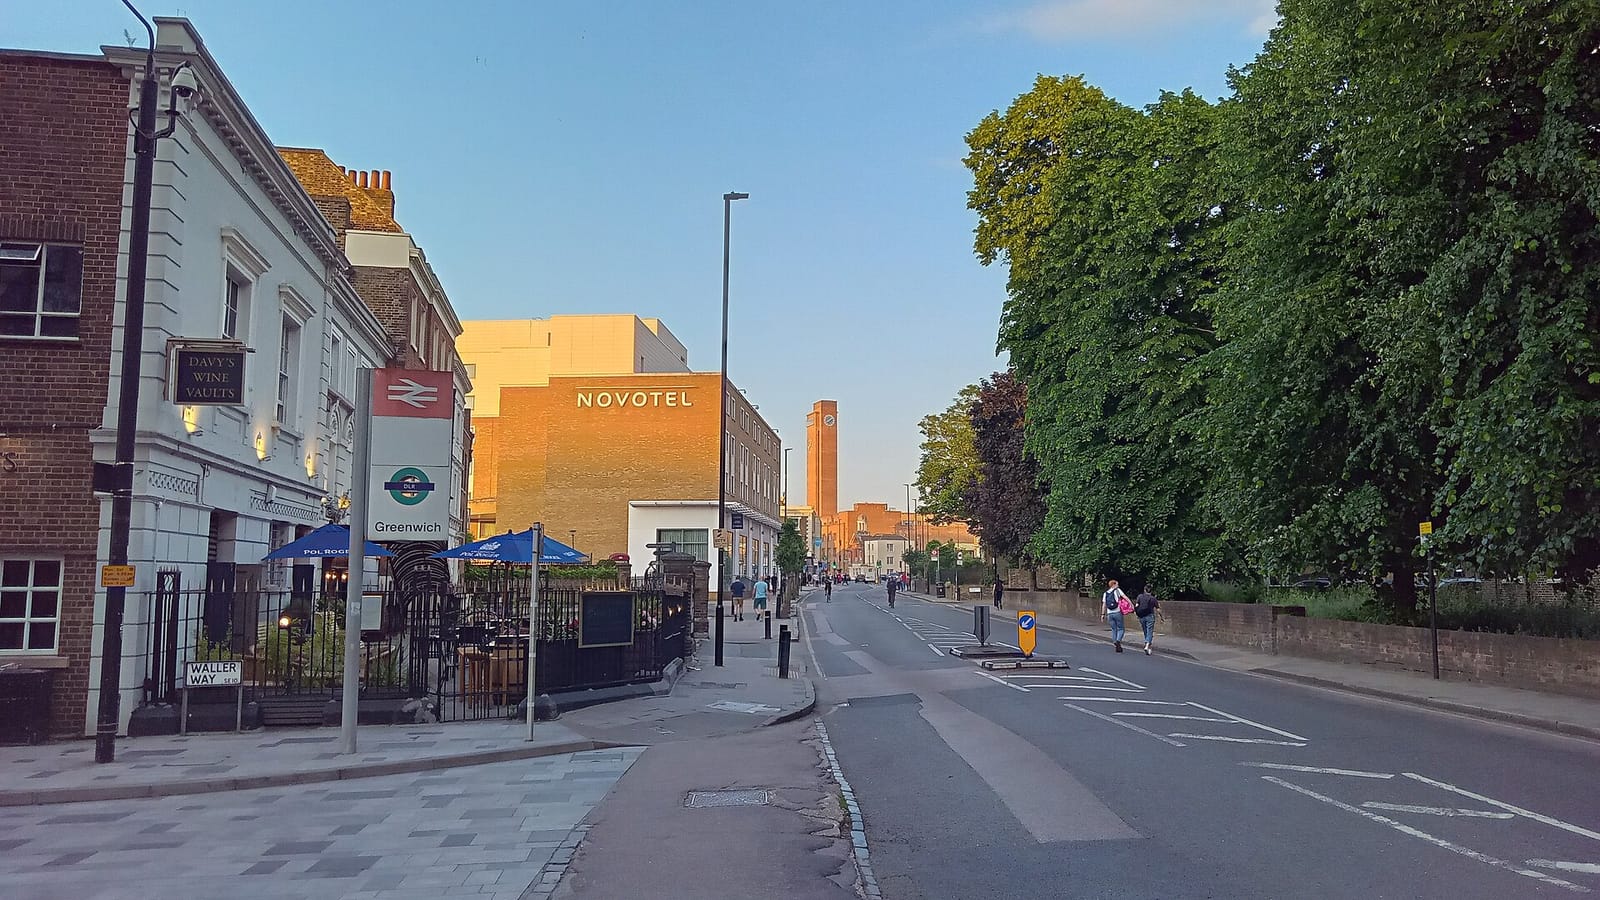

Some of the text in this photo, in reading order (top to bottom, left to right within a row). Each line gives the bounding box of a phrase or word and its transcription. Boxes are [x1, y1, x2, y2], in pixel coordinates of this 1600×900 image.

[189, 357, 235, 368] DAVY'S
[193, 372, 229, 383] WINE
[186, 387, 235, 398] VAULTS
[577, 391, 693, 408] NOVOTEL
[375, 521, 441, 533] Greenwich
[191, 662, 237, 674] WALLER
[190, 674, 217, 685] WAY
